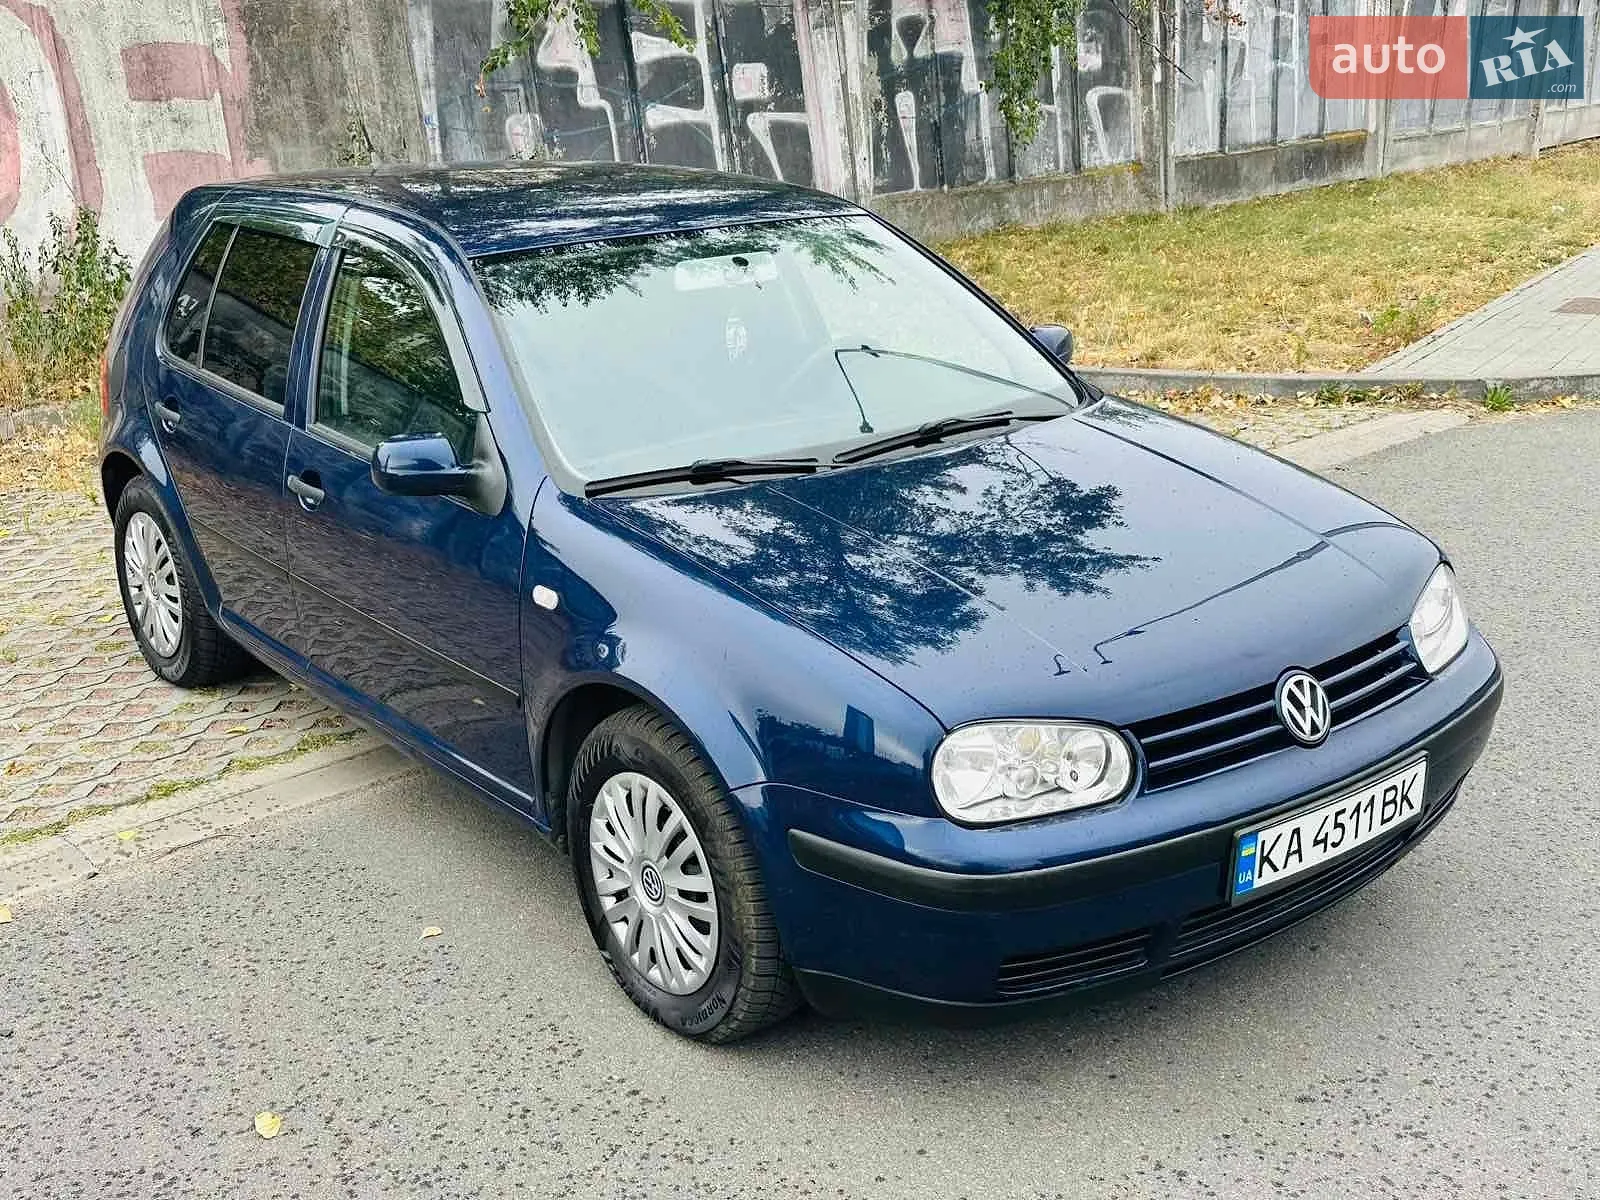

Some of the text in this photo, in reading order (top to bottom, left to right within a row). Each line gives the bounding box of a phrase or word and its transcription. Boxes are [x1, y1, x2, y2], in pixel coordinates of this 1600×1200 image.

[1281, 674, 1330, 741] VW
[1257, 772, 1418, 879] KA 4511 BK
[1238, 869, 1253, 884] UA
